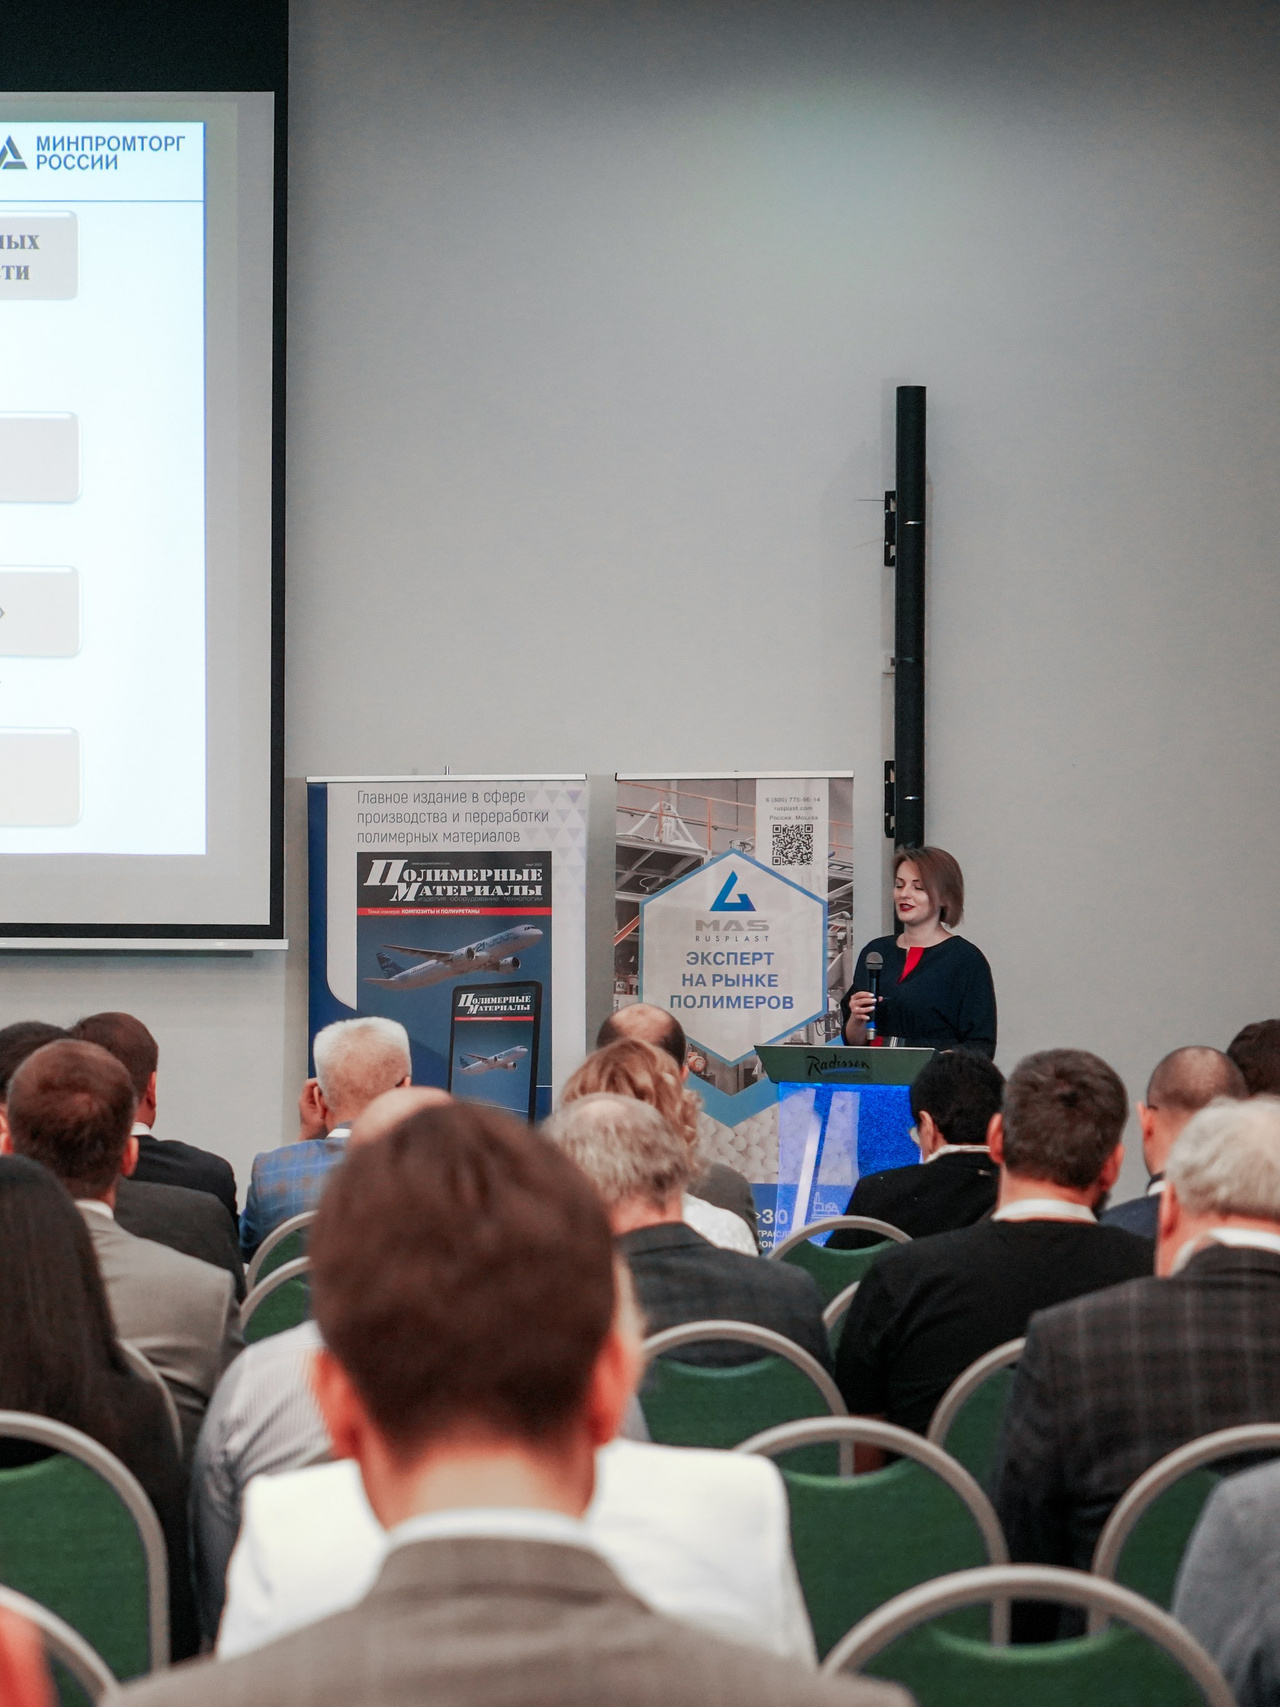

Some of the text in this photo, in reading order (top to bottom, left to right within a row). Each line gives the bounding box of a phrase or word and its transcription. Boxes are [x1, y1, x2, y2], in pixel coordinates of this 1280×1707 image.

[37, 136, 185, 152] МИНПРОМТОРГ
[37, 154, 118, 171] РОССИИ
[357, 790, 526, 806] Главное издание в сфере
[357, 809, 550, 826] производства и переработки
[357, 831, 521, 846] полимерных материалов
[363, 859, 543, 886] ПОЛИМЕРНЫЕ
[389, 883, 543, 902] МАТЕРИАЛЫ
[695, 920, 770, 932] MAS
[686, 951, 774, 966] ЭКСПЕРТ
[681, 973, 779, 988] НА РЫНКЕ
[669, 995, 795, 1010] ПОЛИМЕРОВ
[806, 1053, 870, 1077] Radisson
